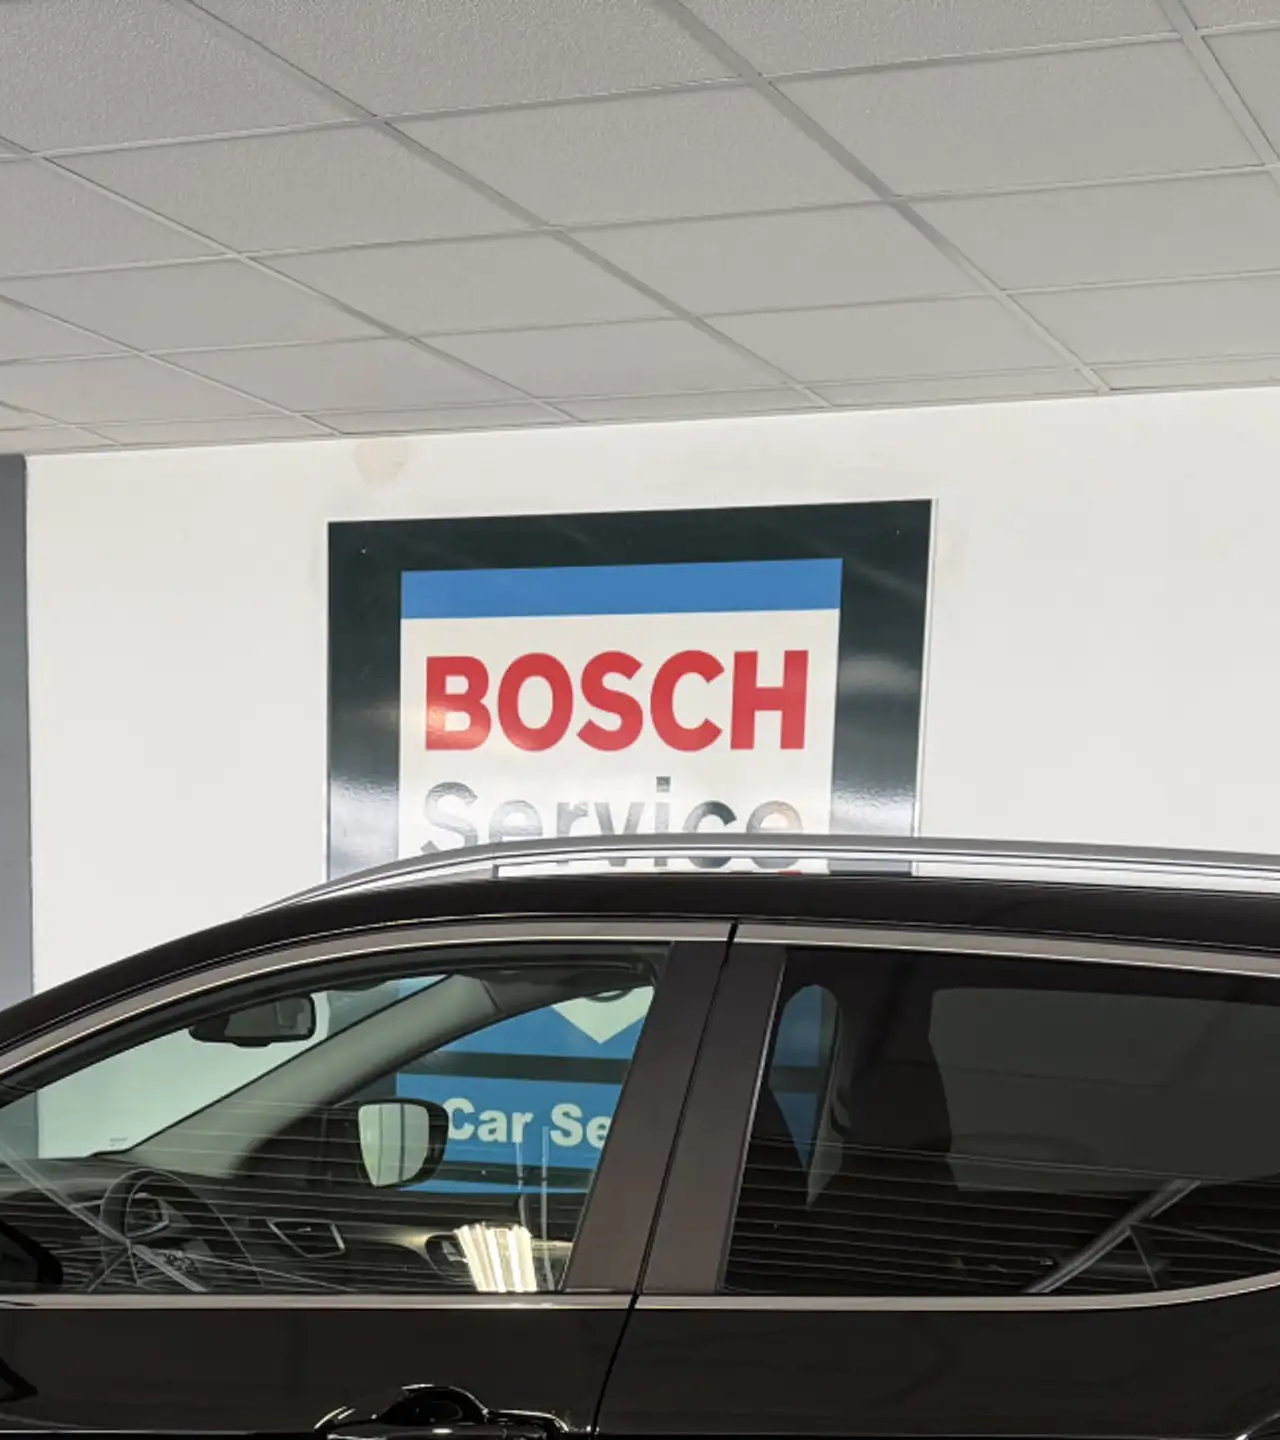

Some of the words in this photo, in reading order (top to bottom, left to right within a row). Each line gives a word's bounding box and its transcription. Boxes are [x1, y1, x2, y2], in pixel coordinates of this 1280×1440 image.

[425, 649, 809, 752] BOSCH
[421, 776, 803, 869] Service
[443, 1098, 535, 1143] Car
